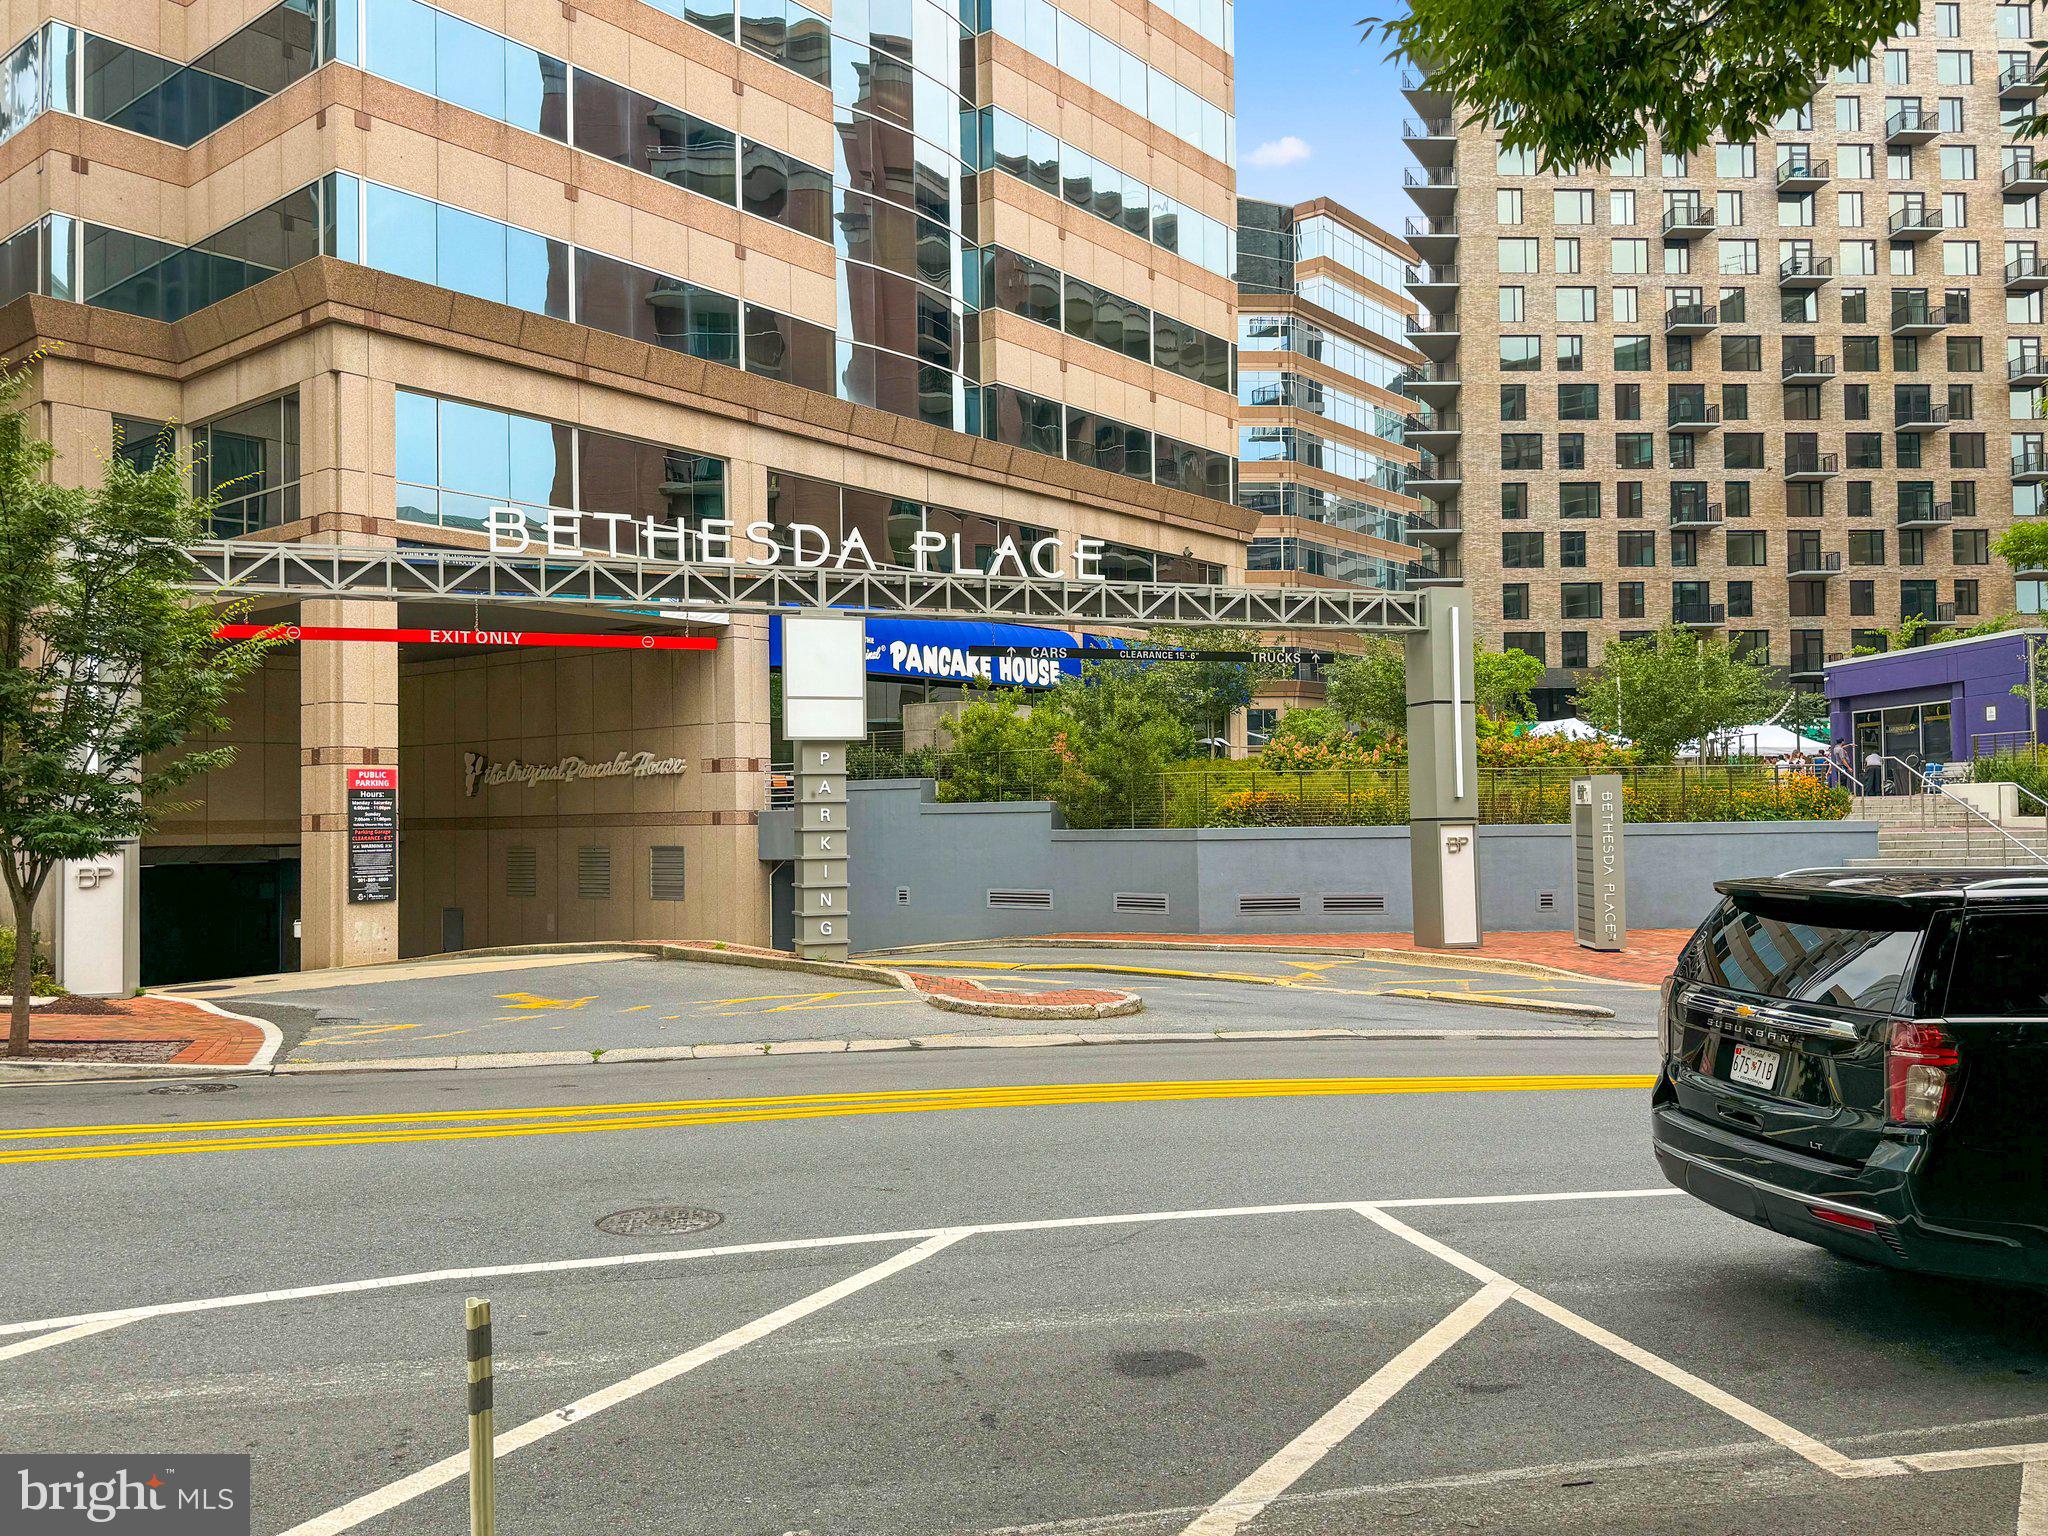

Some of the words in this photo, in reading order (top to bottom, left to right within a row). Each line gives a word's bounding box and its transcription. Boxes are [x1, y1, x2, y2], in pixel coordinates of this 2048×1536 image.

[483, 506, 877, 571] BETHESDA
[908, 529, 1106, 581] PLACE
[430, 629, 471, 643] EXIT
[475, 631, 523, 645] ONLY
[1030, 647, 1068, 659] CARS
[1119, 650, 1174, 660] CLEARANCE
[1175, 651, 1200, 661] 15'-6"
[1251, 652, 1301, 663] TRUCKS
[889, 640, 992, 681] PANCAKE
[999, 656, 1061, 686] HOUSE
[358, 771, 387, 779] PUBLIC
[505, 758, 566, 788] Original
[564, 751, 634, 782] Pancake
[630, 750, 687, 777] House
[355, 779, 390, 787] PARKING
[360, 790, 385, 798] Hours:
[1601, 791, 1615, 876] BETHESDA
[818, 751, 833, 936] PARKING
[75, 867, 115, 889] BP
[1603, 883, 1617, 934] PLACE
[1706, 1018, 1791, 1043] SUBURBAN
[1809, 1140, 1823, 1151] LT
